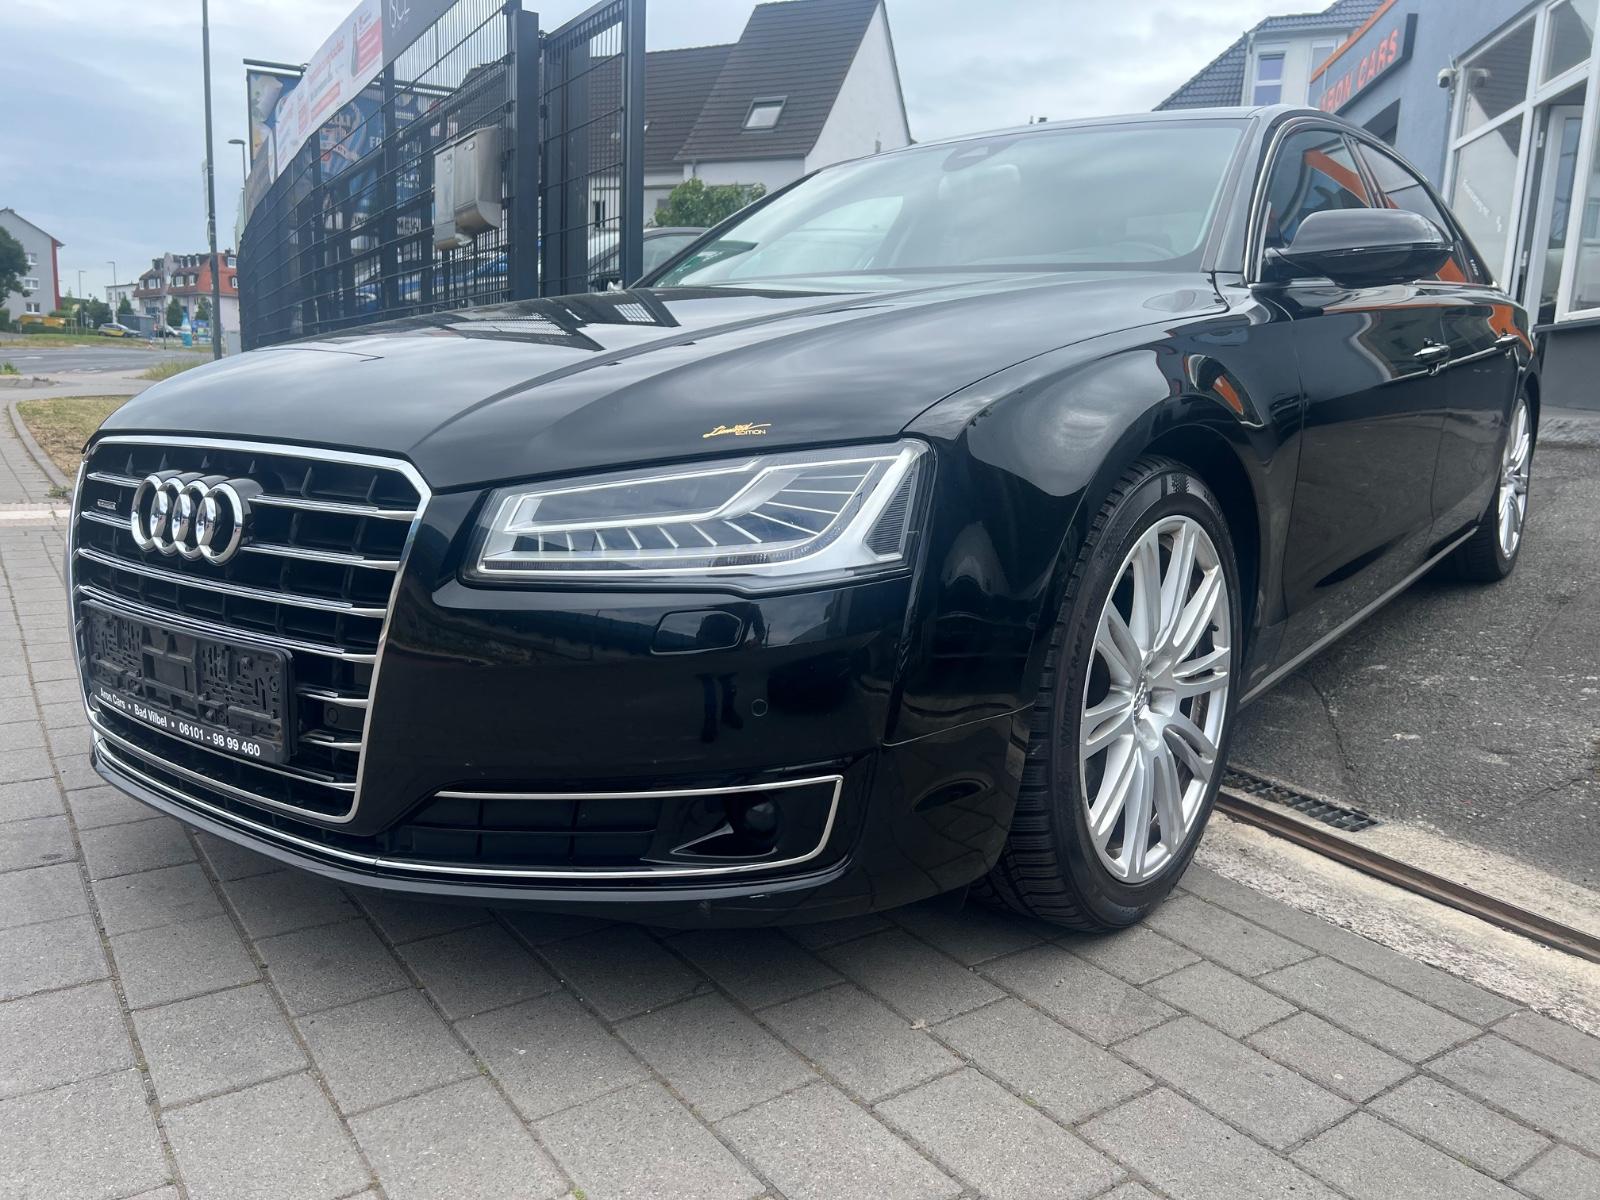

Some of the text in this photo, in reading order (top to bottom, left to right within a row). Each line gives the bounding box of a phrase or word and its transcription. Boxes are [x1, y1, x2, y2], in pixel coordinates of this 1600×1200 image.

[1357, 28, 1397, 91] CARS
[100, 687, 112, 702] Aron
[112, 694, 126, 709] Cars
[134, 703, 147, 719] Bad
[147, 709, 168, 728] Vilbel
[179, 721, 204, 740] 06101
[212, 733, 225, 747] 98
[226, 737, 239, 751] 99
[241, 741, 260, 757] 460
